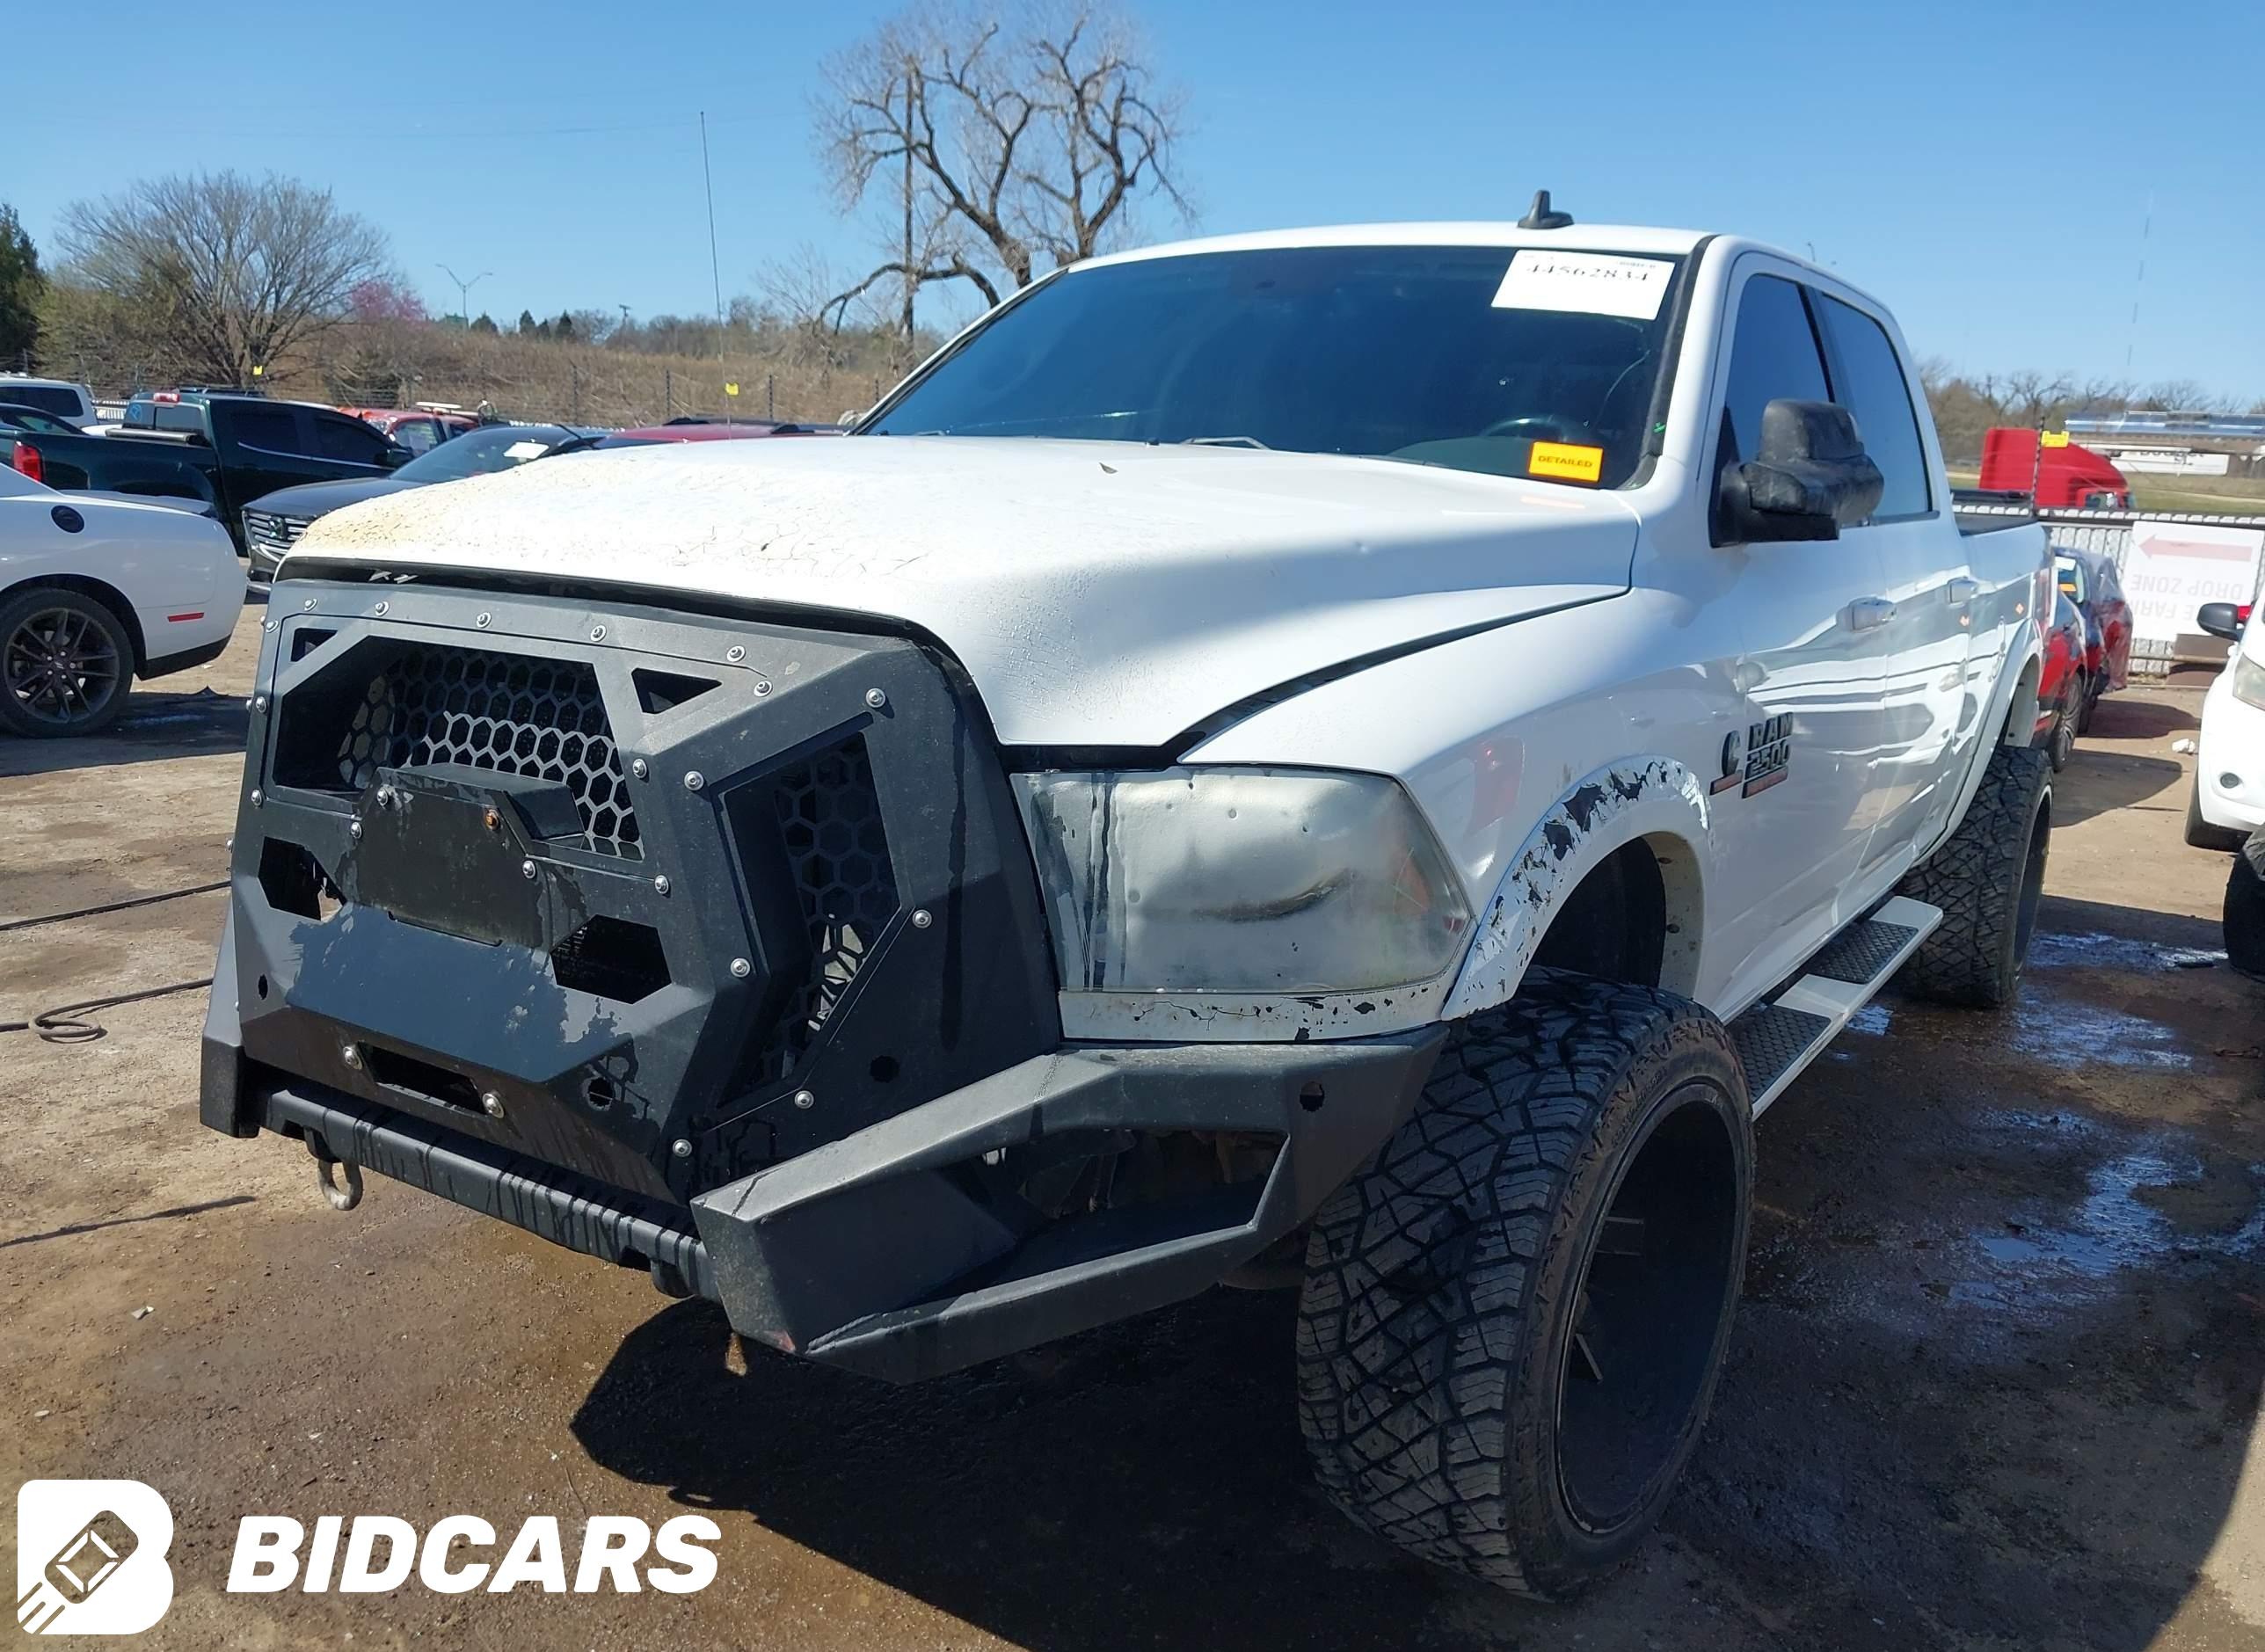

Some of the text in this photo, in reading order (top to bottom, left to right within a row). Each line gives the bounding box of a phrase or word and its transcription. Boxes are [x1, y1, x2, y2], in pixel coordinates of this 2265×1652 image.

[1538, 455, 1592, 468] DETAILED
[2130, 574, 2244, 600] DROP ZONE
[1748, 712, 1794, 751] RAM
[1744, 739, 1790, 779] 2500
